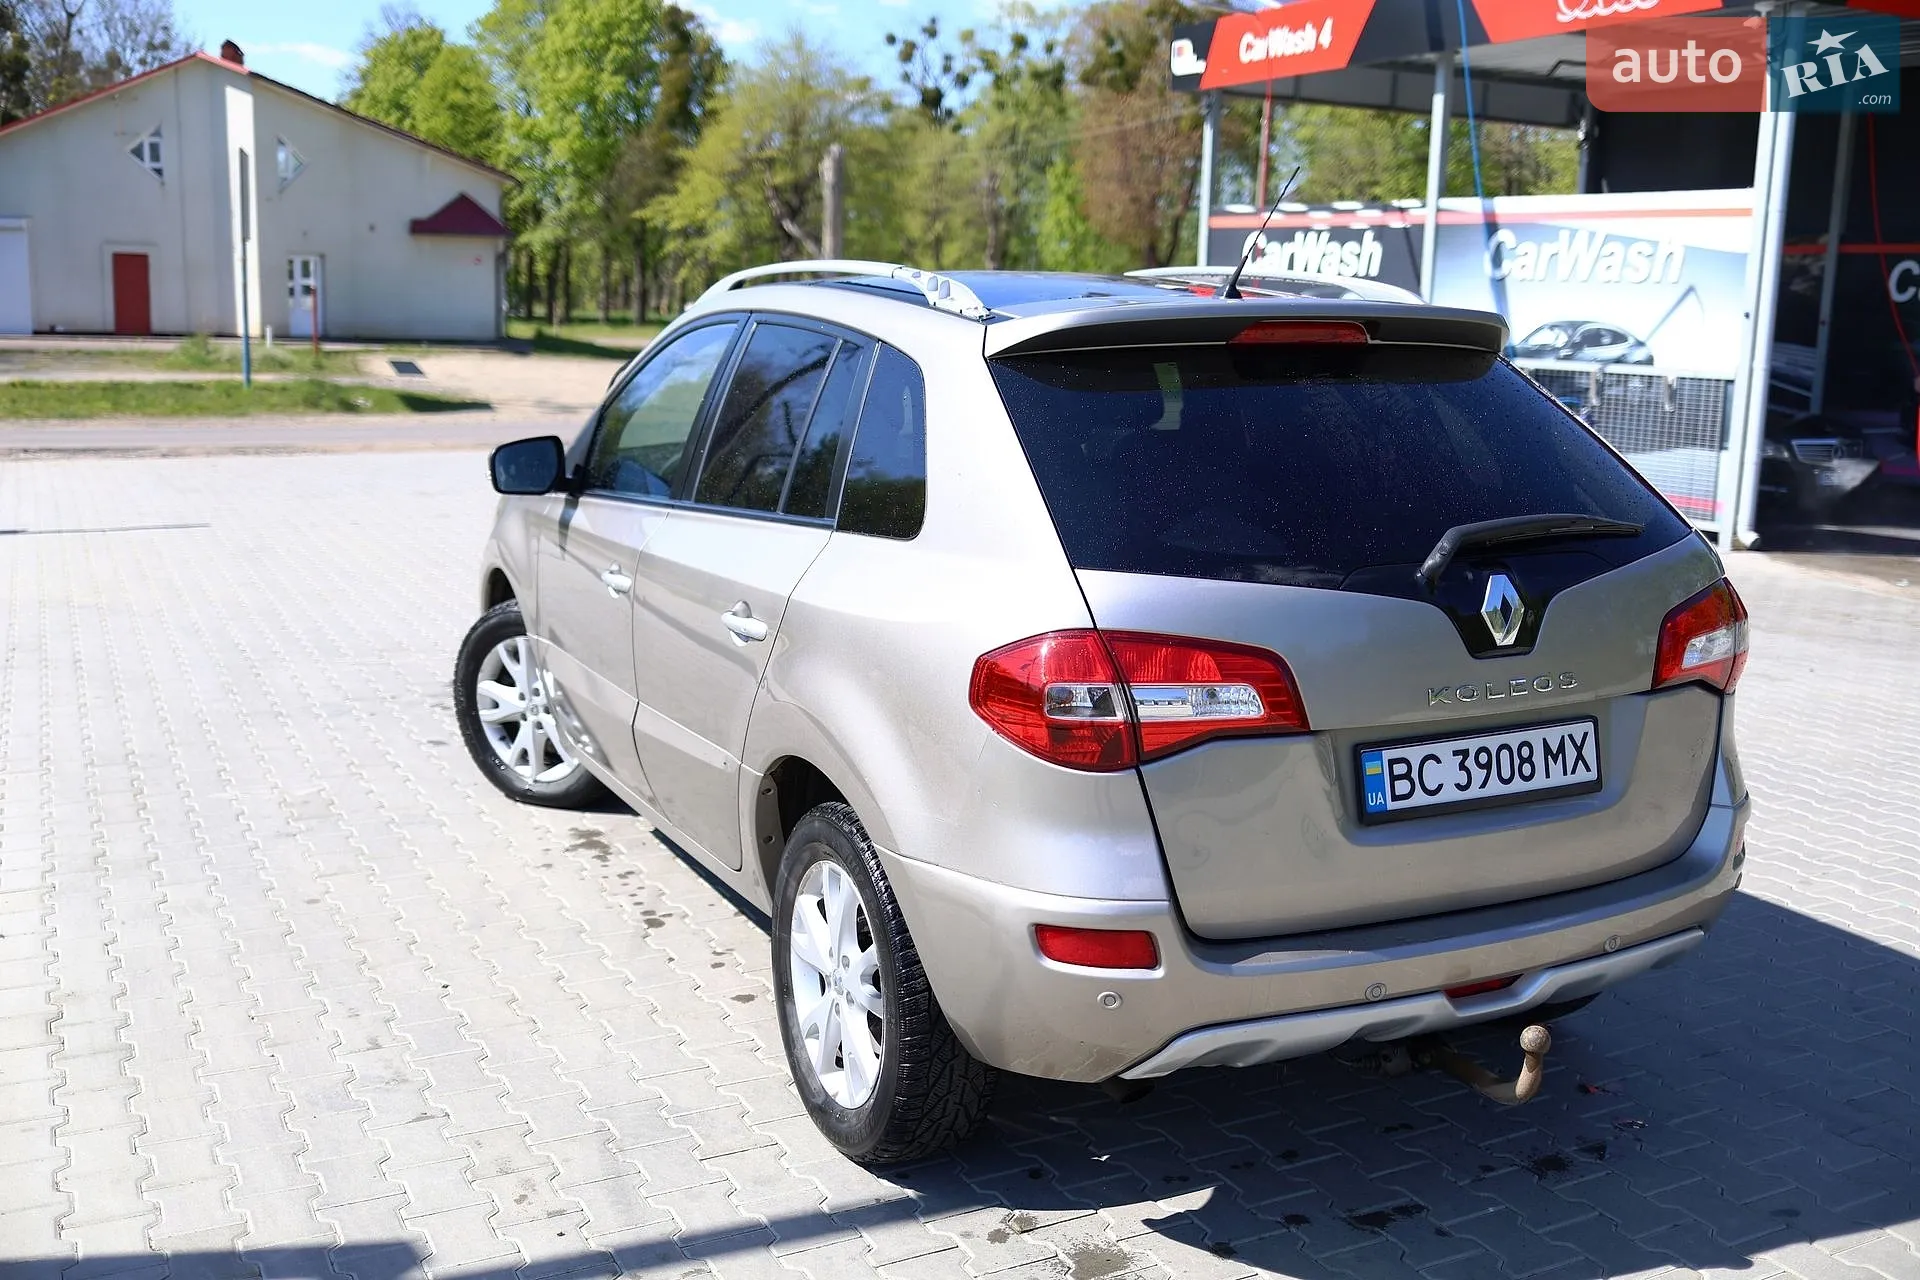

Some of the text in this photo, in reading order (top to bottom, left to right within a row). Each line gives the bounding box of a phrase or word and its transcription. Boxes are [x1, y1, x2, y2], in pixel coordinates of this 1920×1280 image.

[1239, 21, 1317, 64] CarWash
[1241, 230, 1383, 278] CarWash
[1483, 228, 1687, 284] CarWash
[1427, 671, 1578, 706] KOLEOS
[1387, 731, 1592, 803] BC 3908 MX
[1368, 792, 1385, 806] UA
